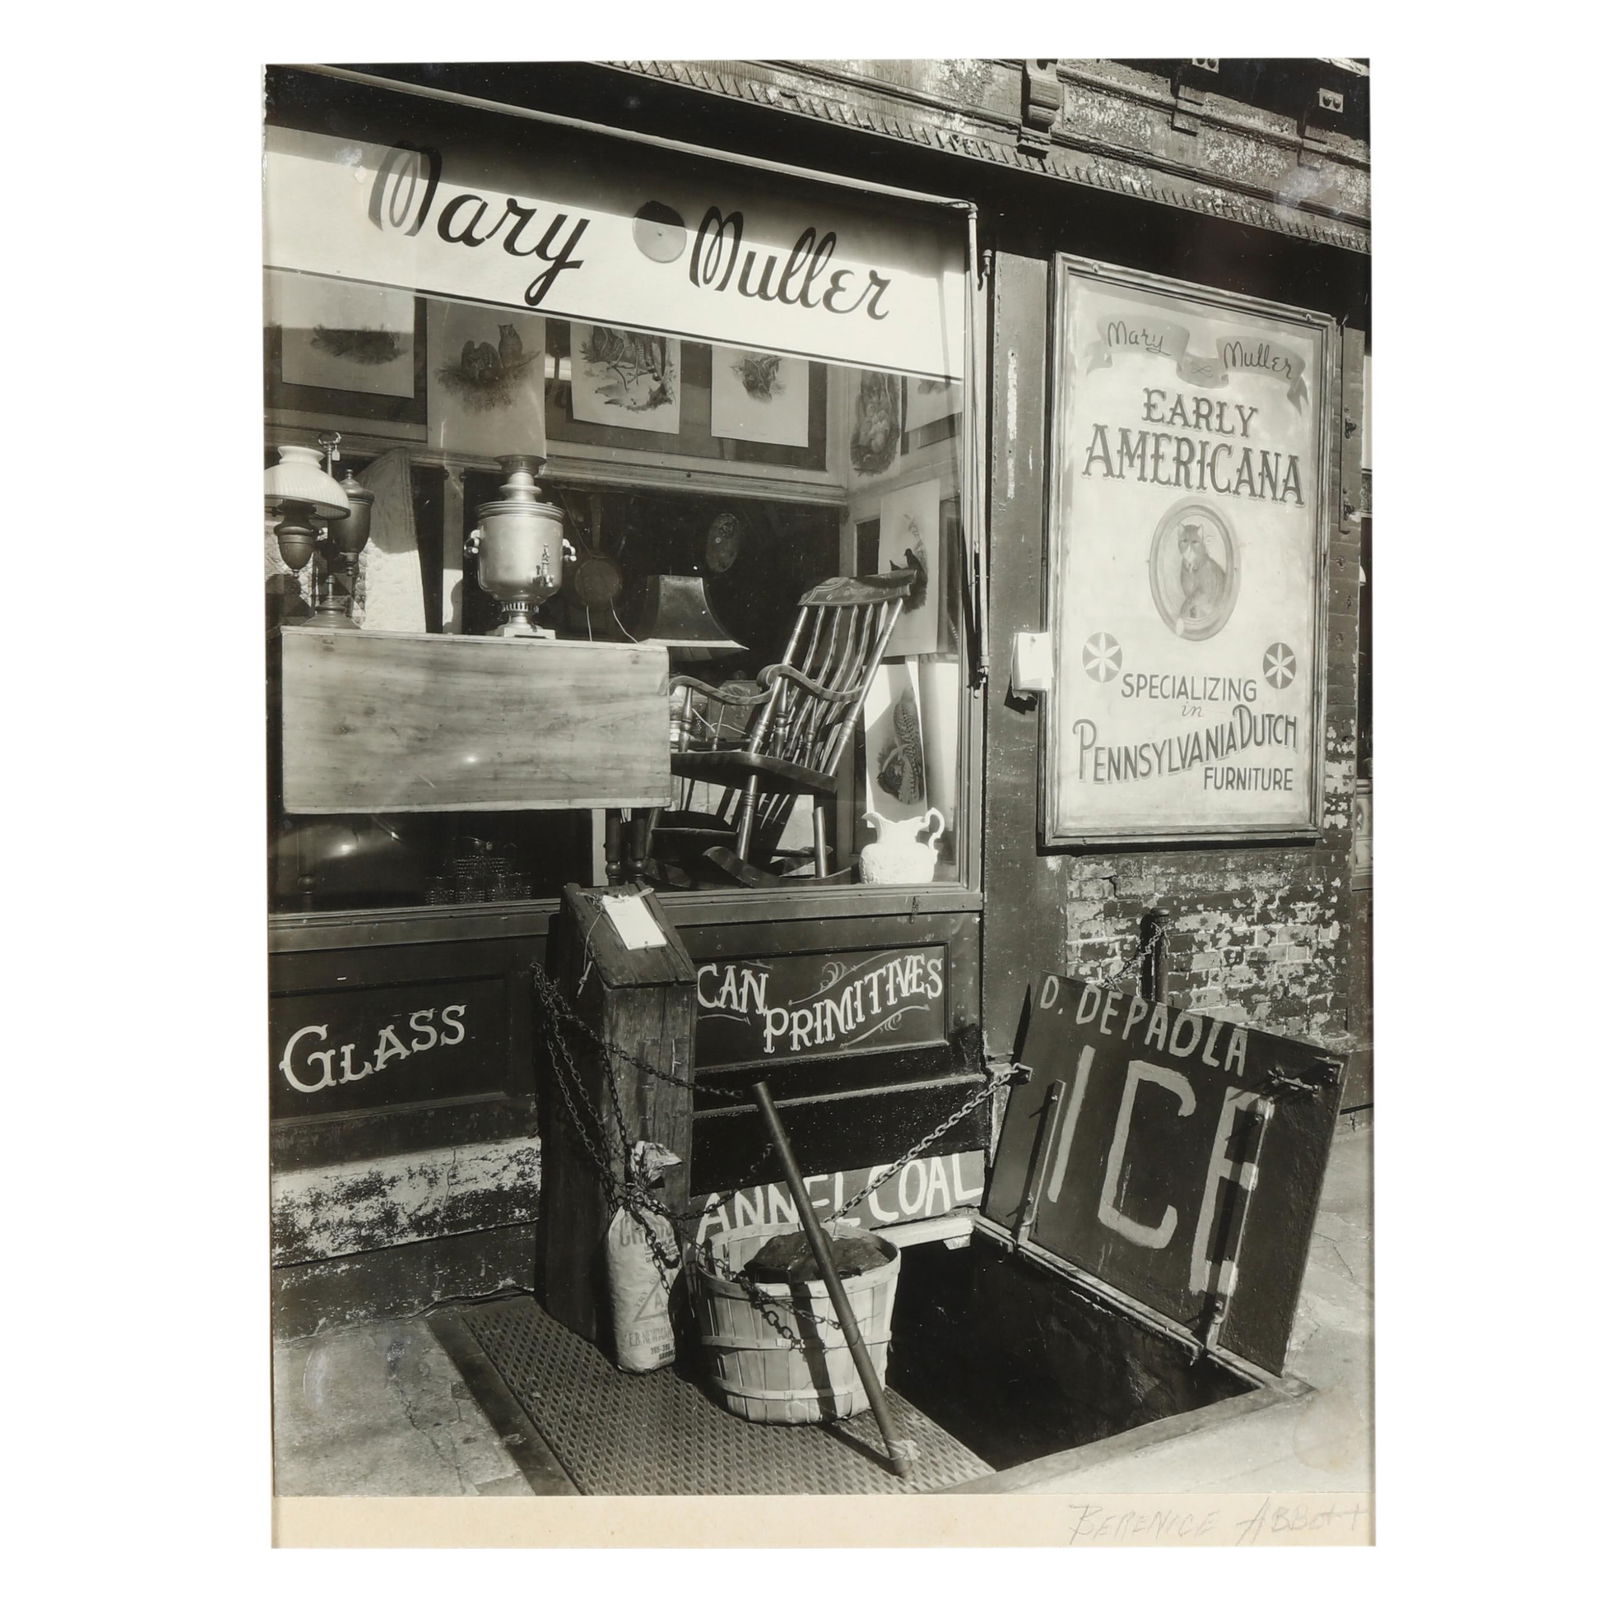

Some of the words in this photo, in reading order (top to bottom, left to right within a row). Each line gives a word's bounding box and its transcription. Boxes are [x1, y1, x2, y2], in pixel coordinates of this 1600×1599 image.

[367, 141, 591, 306] Mary
[689, 206, 890, 320] Muller
[1107, 320, 1171, 357] Mary
[1224, 340, 1292, 379] Muller
[1141, 387, 1258, 437] EARLY
[1082, 423, 1305, 505] AMERICANA
[1121, 673, 1257, 701] SPECIALIZING
[1181, 702, 1204, 718] in
[1073, 718, 1238, 785] PENNSYLVANIA
[1232, 704, 1298, 750] DUTCH
[1203, 766, 1293, 791] FURNITURE
[763, 953, 943, 1054] PRIMITIVES
[1040, 975, 1065, 1015] D.
[1075, 983, 1249, 1077] DEPAOLA
[279, 1004, 468, 1093] GLASS
[868, 1153, 985, 1224] COAL
[1047, 1044, 1275, 1296] ICE
